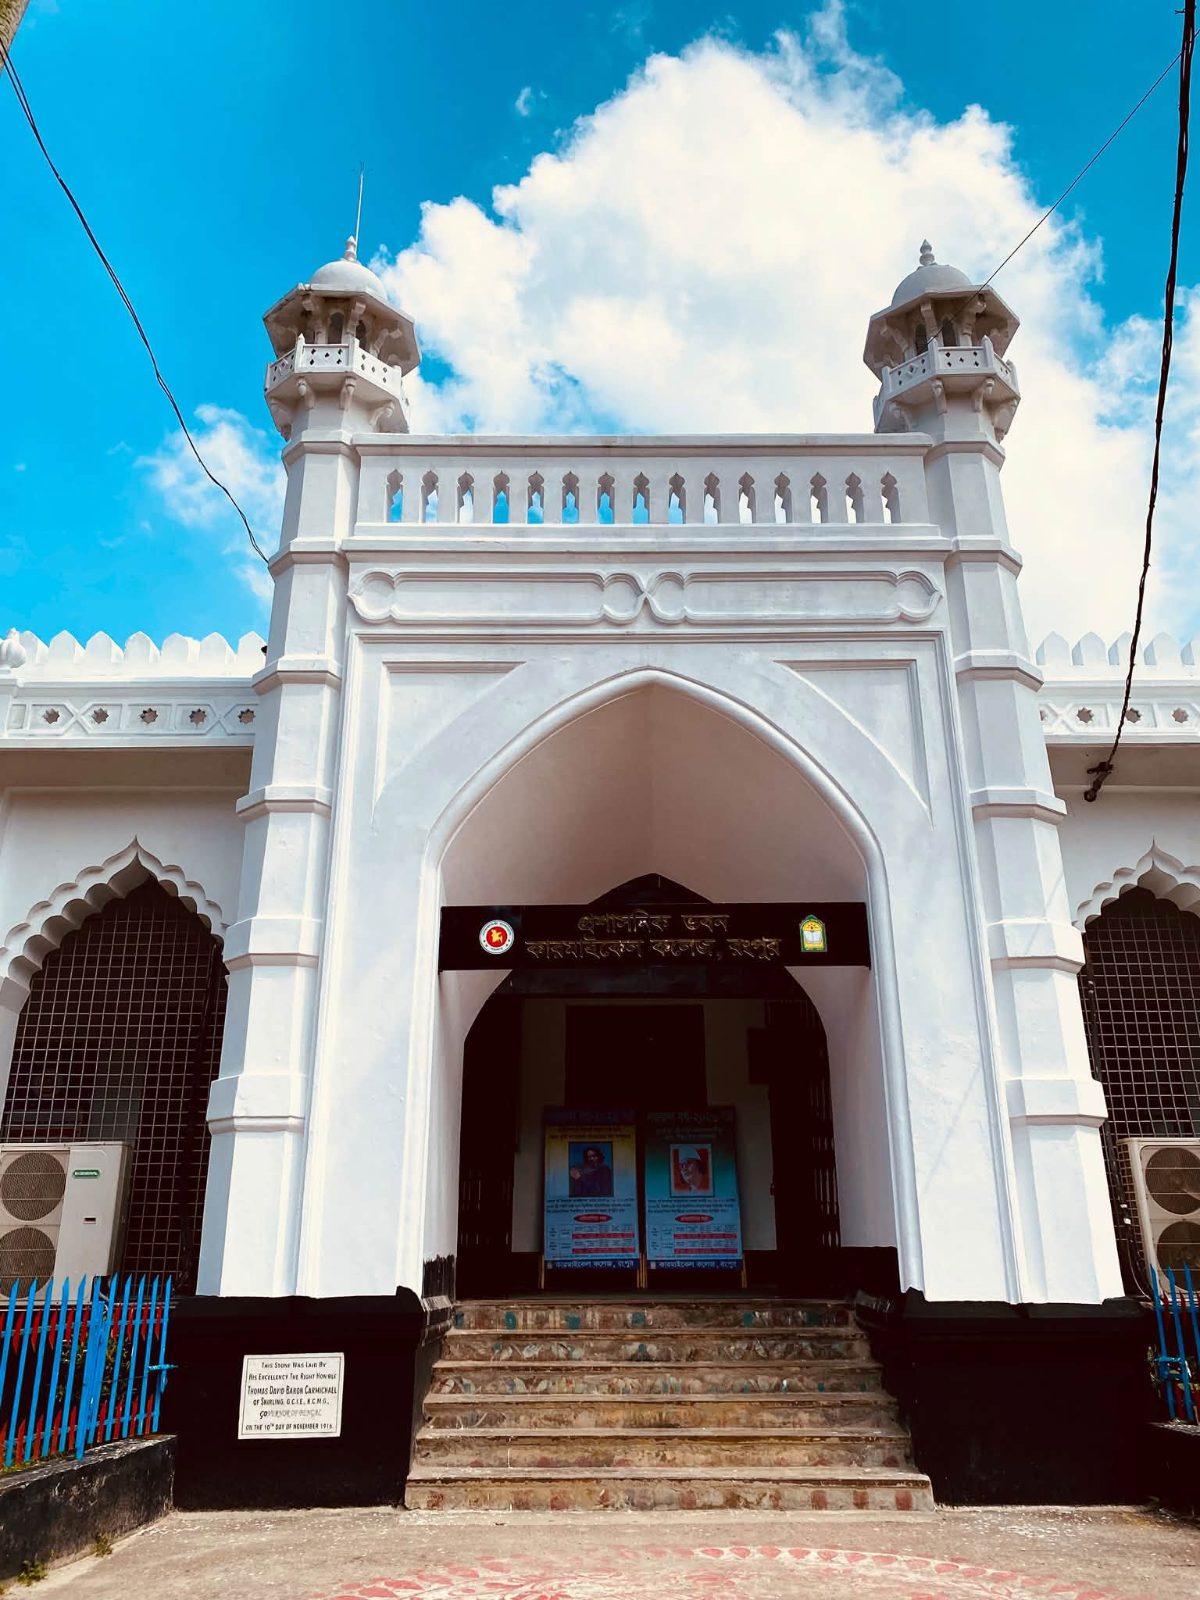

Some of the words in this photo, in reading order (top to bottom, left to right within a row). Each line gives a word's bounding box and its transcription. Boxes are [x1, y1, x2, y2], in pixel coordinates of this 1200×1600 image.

[577, 909, 671, 934] প্রশাসনিক
[680, 915, 730, 933] ভবন
[524, 934, 645, 959] কারমাইকেল
[726, 936, 782, 960] রংপুর
